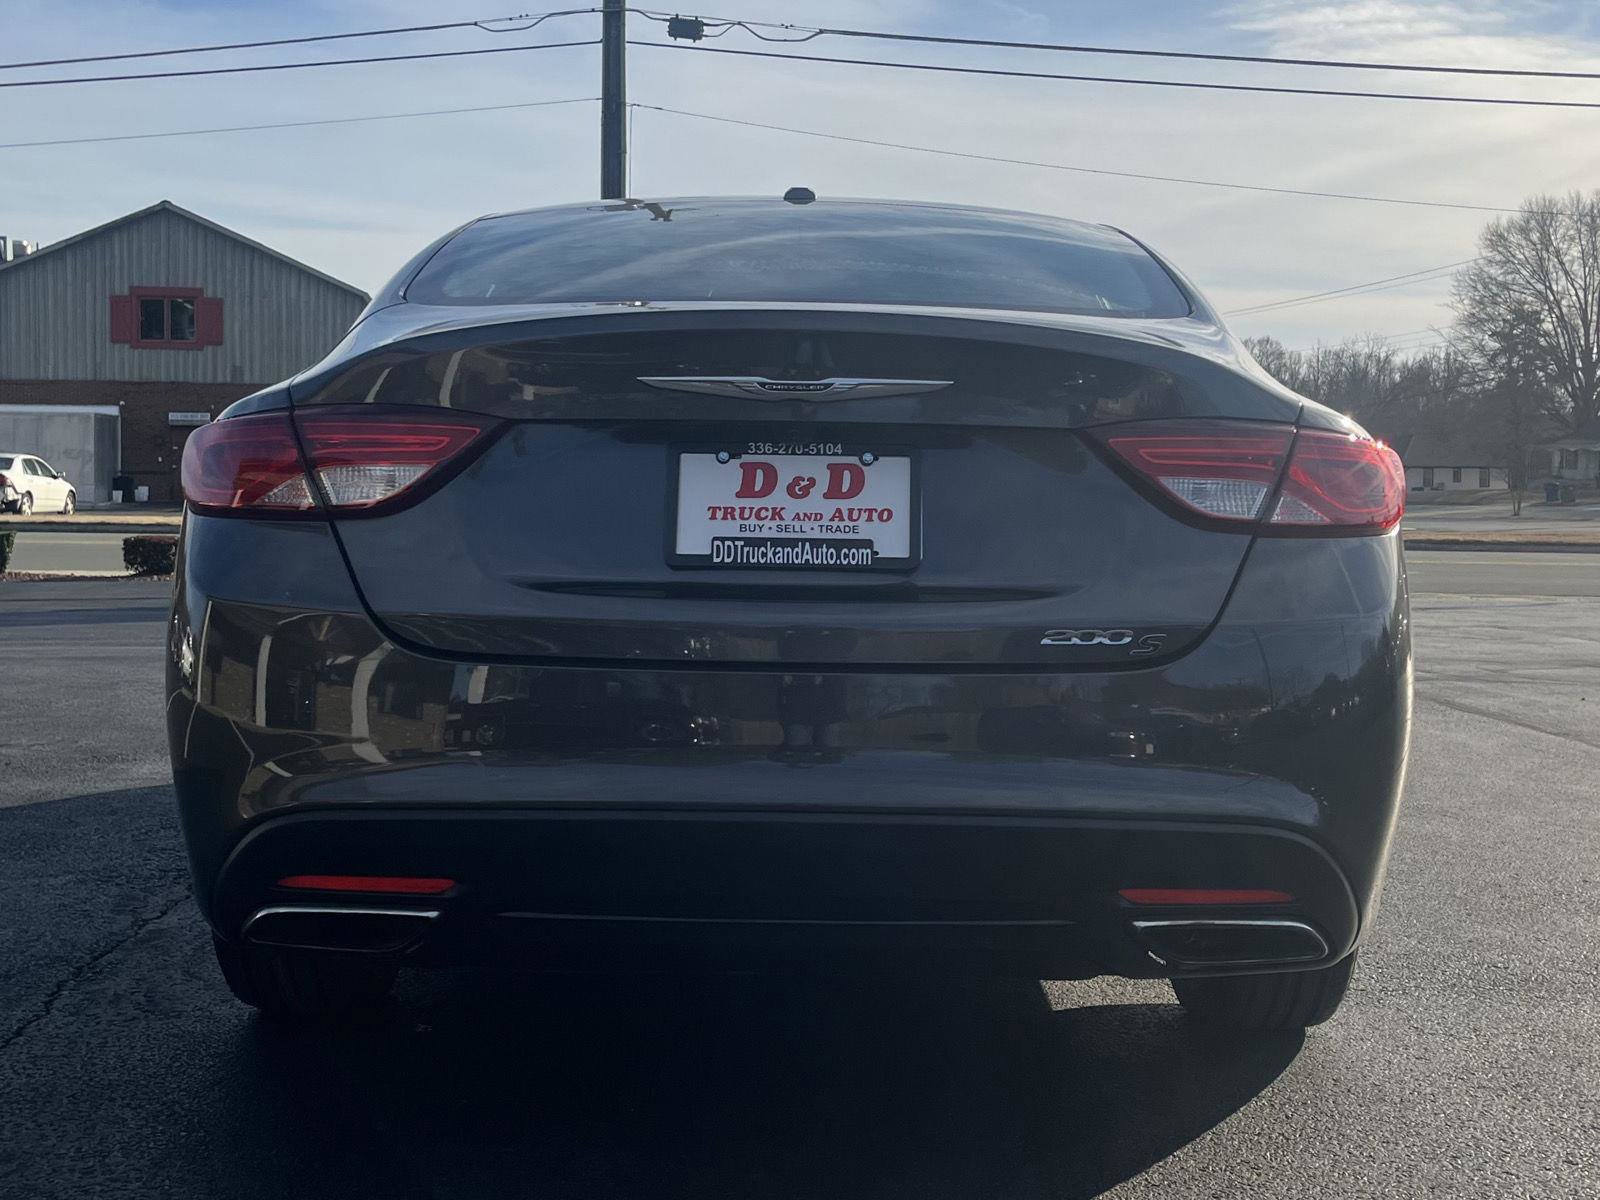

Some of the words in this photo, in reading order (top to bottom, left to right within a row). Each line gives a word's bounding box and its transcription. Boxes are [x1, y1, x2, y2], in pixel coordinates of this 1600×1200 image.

[735, 462, 778, 498] D
[786, 476, 816, 499] &
[823, 463, 865, 499] D
[707, 506, 786, 521] TRUCK
[792, 511, 824, 522] AND
[829, 508, 893, 522] AUTO
[818, 525, 860, 534] TRADE
[713, 540, 872, 565] DDTruckandAuto.com
[1040, 629, 1134, 645] 200
[1129, 634, 1168, 656] S
